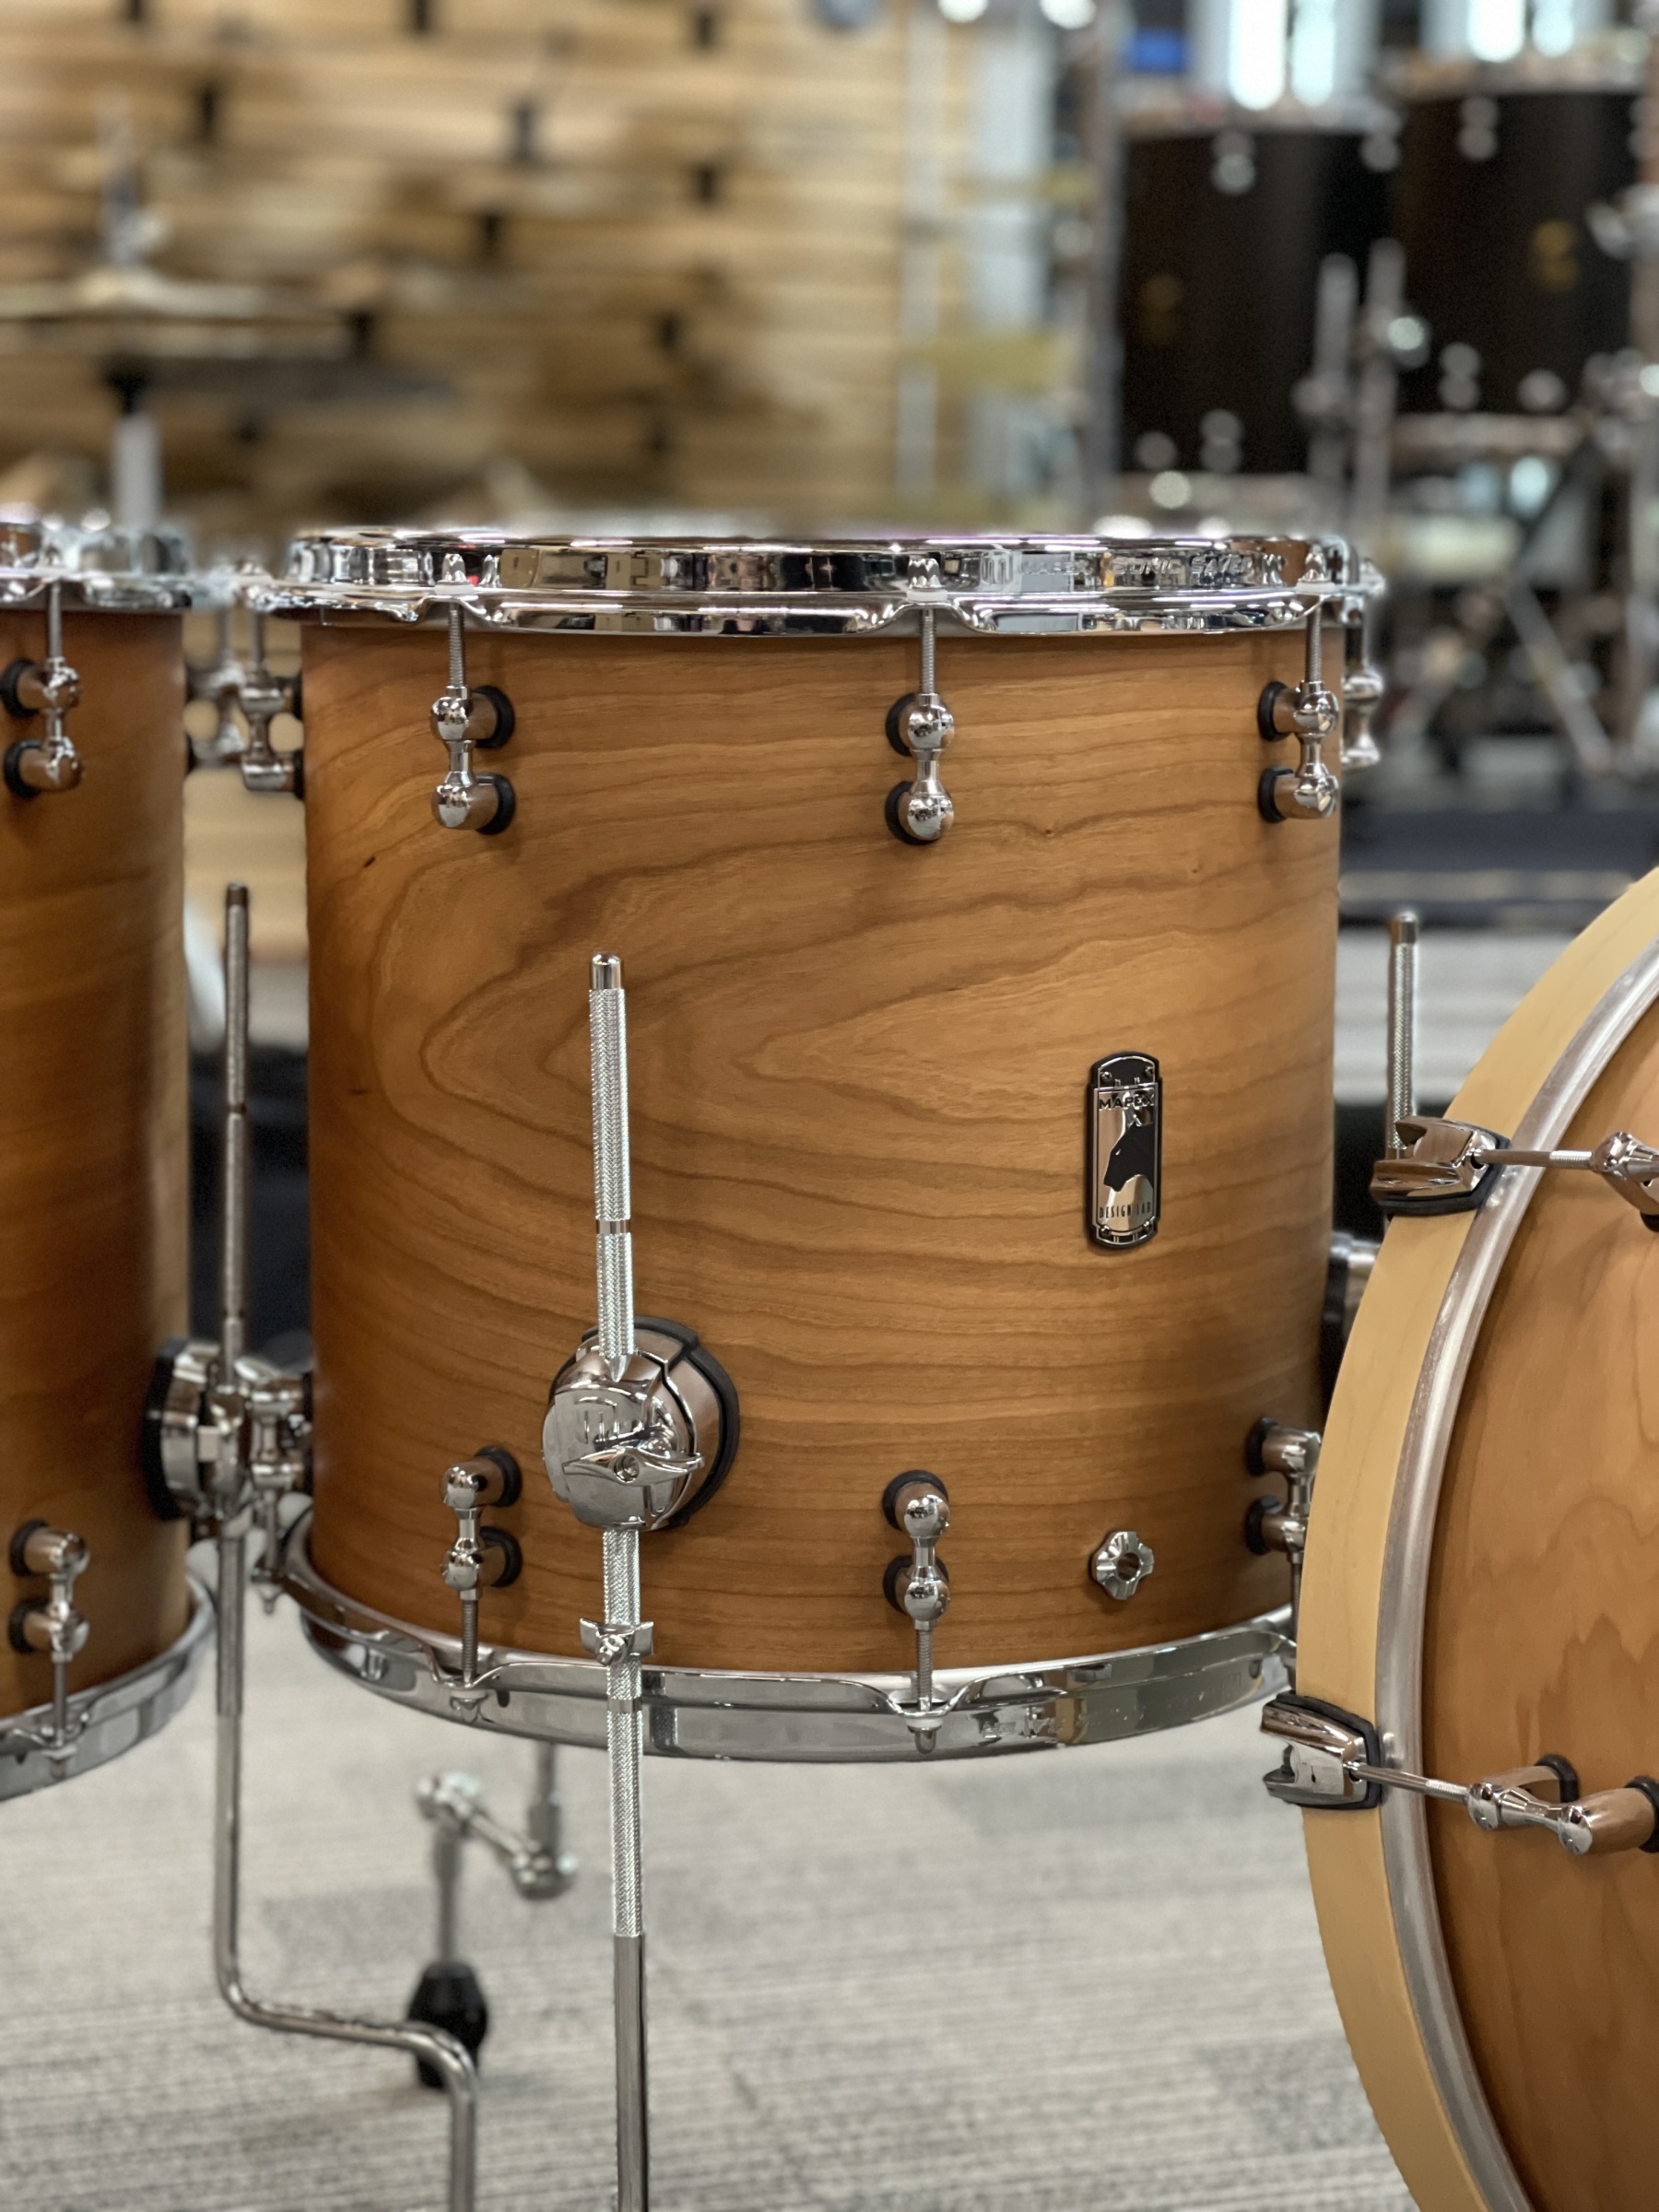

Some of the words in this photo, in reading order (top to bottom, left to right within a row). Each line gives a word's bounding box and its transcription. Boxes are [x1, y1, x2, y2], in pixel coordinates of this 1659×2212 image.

[1112, 557, 1182, 575] SONIC
[1191, 555, 1253, 575] SAVER
[1099, 1093, 1154, 1110] MAPEX
[1099, 1204, 1132, 1219] DESIGN
[1136, 1201, 1151, 1216] LAB
